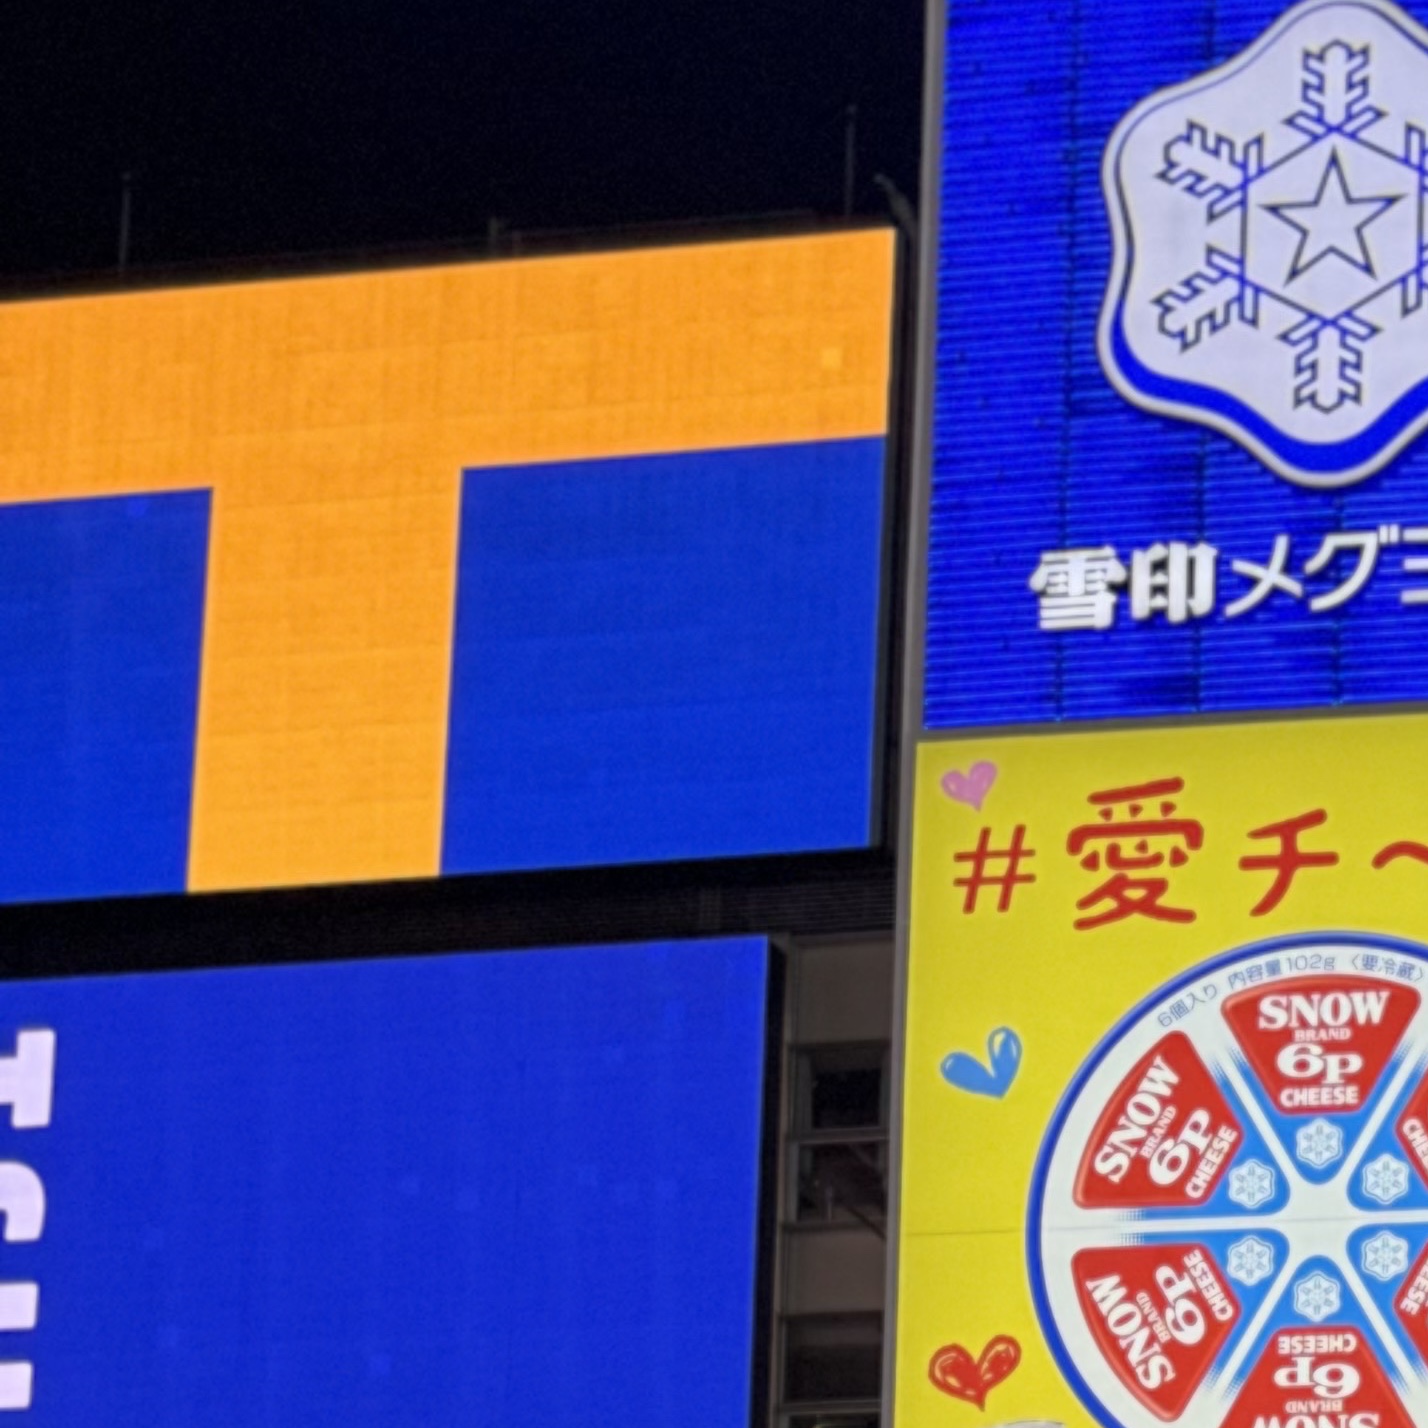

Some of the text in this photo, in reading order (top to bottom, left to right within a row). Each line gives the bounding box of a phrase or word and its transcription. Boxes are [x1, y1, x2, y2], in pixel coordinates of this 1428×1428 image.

[1257, 991, 1390, 1030] SNOW
[1293, 1027, 1352, 1043] BRAND
[1094, 1055, 1181, 1184] SNOW
[1280, 1085, 1359, 1109] CHEESE
[1139, 1105, 1177, 1158] BRAND
[1185, 1125, 1239, 1200] CHEESE
[1183, 1248, 1234, 1322] CHEESE
[1086, 1274, 1176, 1389] SNOW
[1277, 1334, 1357, 1355] CHEESE
